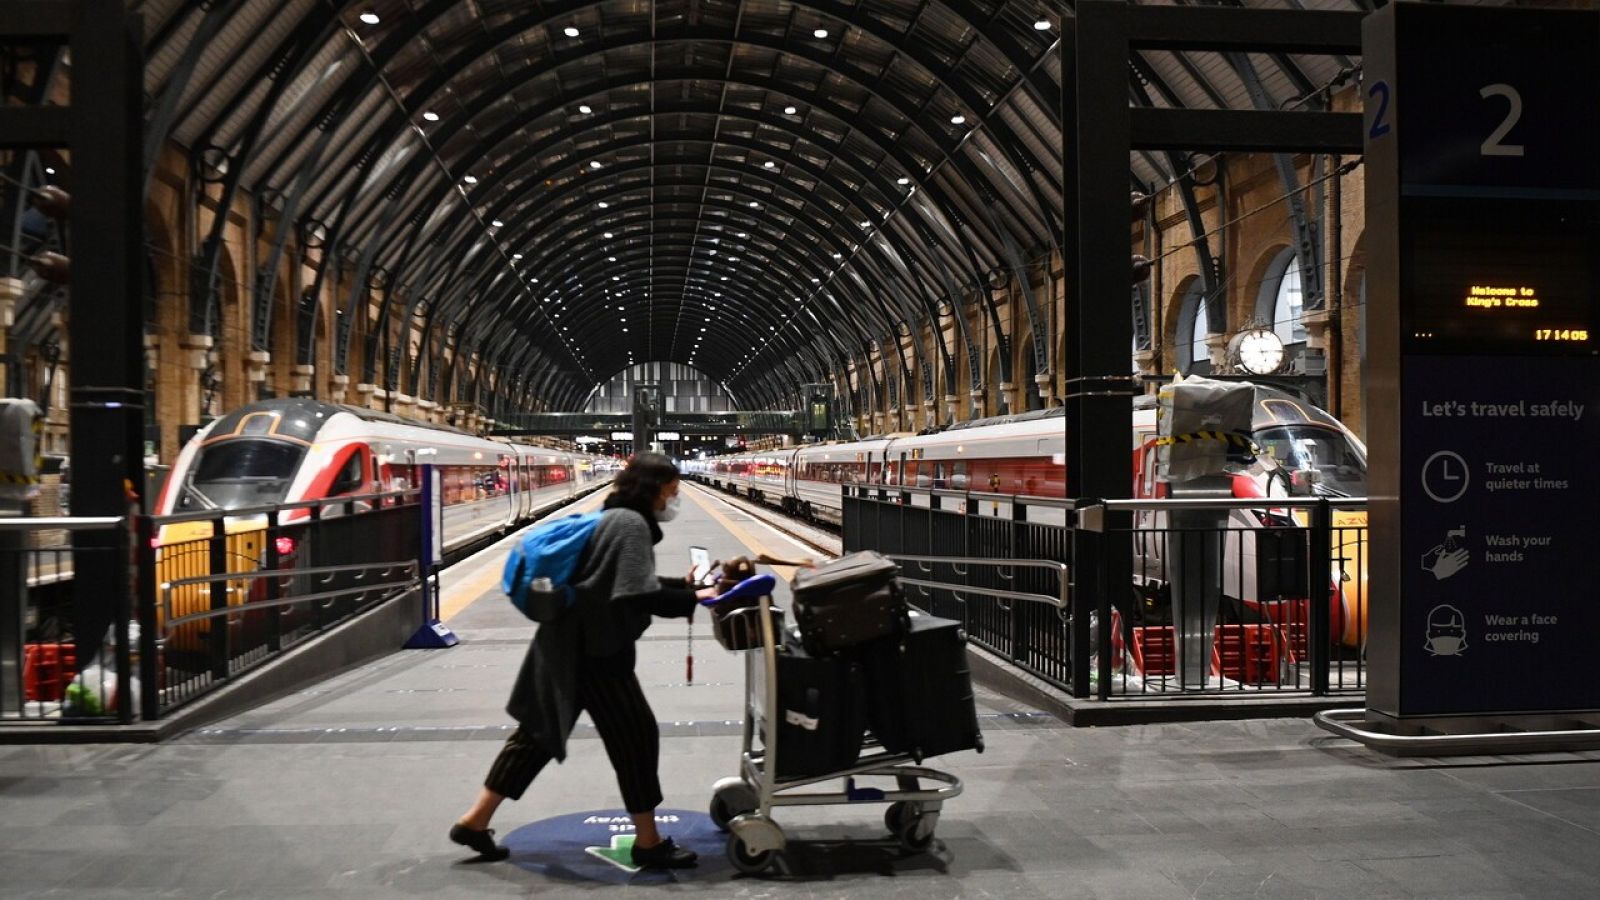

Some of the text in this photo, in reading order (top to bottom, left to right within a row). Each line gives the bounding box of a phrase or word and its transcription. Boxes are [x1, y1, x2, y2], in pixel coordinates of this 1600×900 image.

[1369, 81, 1391, 139] 2
[1479, 83, 1524, 156] 2
[1471, 286, 1534, 296] Welcome to
[1467, 297, 1538, 308] King's Cross
[1422, 400, 1584, 421] Let's travel safely
[1486, 462, 1540, 474] Travel at
[1485, 477, 1568, 491] quieter times
[1485, 534, 1551, 549] Wash your
[1485, 550, 1524, 562] hands
[1485, 613, 1558, 626] Wear a face
[1485, 629, 1540, 643] covering
[584, 815, 631, 824] way
